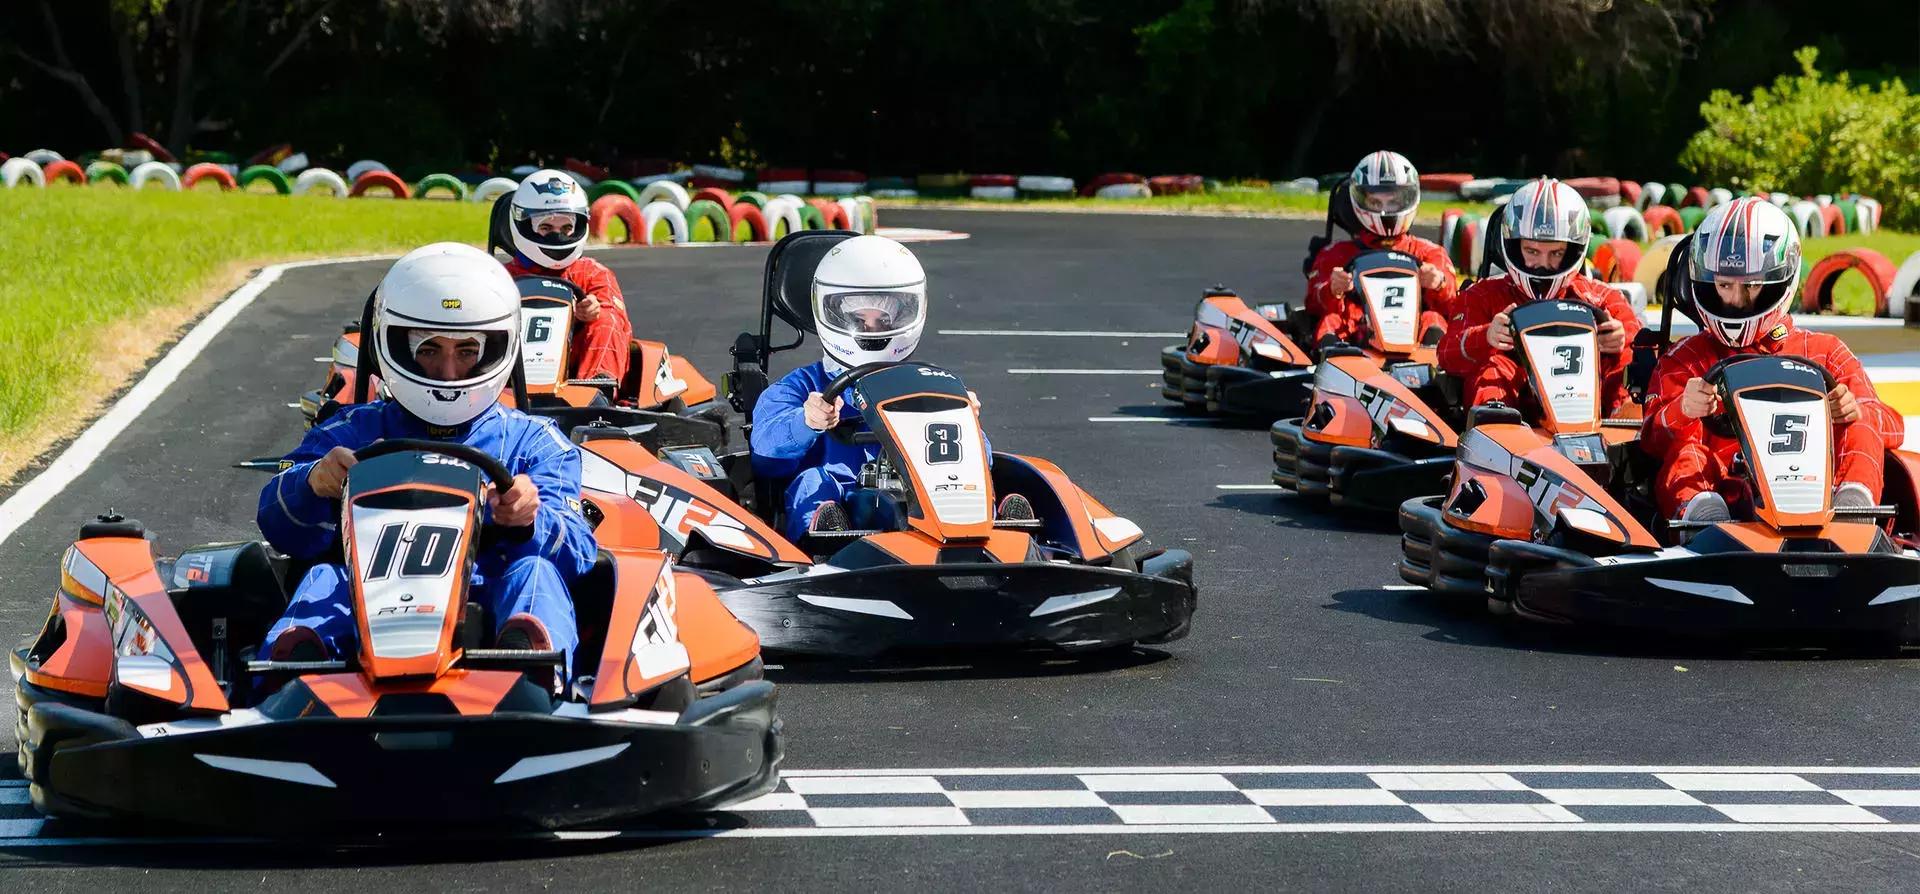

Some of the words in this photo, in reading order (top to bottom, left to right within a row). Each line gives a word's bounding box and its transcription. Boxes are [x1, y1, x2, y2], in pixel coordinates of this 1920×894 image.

[442, 300, 462, 309] OMP
[1382, 286, 1406, 309] 2
[524, 316, 554, 344] 6
[1551, 345, 1585, 377] 3
[925, 422, 963, 466] 8
[1768, 413, 1810, 456] 5
[935, 483, 977, 492] RT8
[363, 521, 464, 583] 10
[378, 605, 436, 616] RT8
